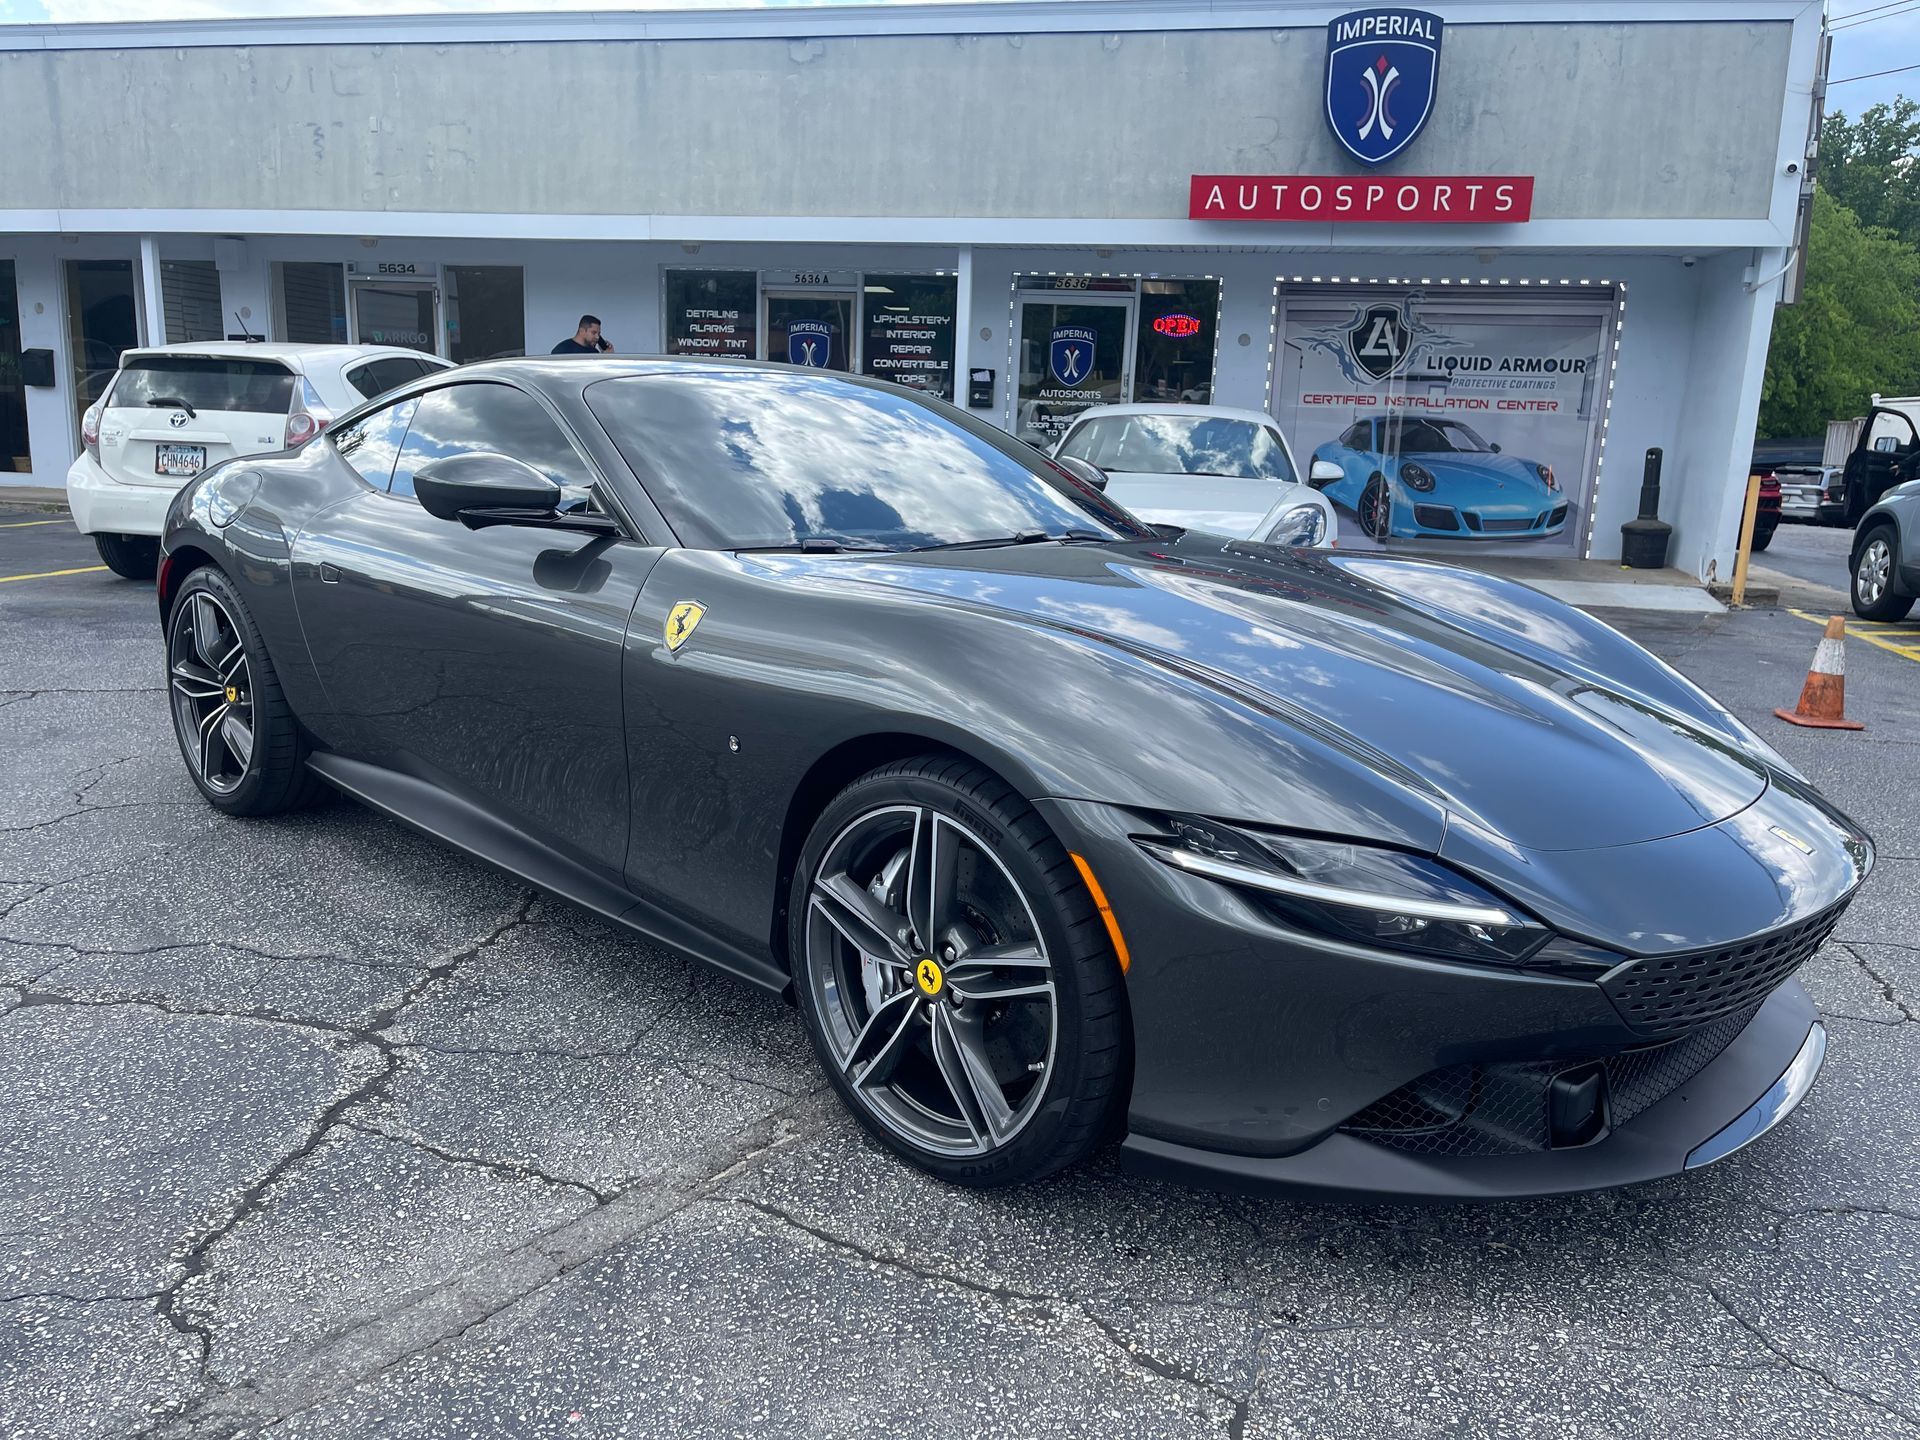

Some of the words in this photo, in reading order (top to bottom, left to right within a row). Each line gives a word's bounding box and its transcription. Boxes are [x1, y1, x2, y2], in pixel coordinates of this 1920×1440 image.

[1336, 16, 1436, 42] IMPERIAL
[1204, 184, 1514, 212] AUTOSPORTS
[379, 263, 416, 274] 5634
[1056, 278, 1088, 289] 5636
[686, 309, 738, 319] DETAILING
[873, 314, 950, 325] UPHOLSTERY
[689, 324, 735, 333] ALARMS
[790, 323, 829, 334] IMPERIAL
[1153, 317, 1200, 334] OPEN
[886, 330, 936, 340] INTERIOR
[1053, 329, 1094, 341] IMPERIAL
[678, 338, 720, 347] WINDOW
[725, 339, 747, 348] TINT
[890, 345, 932, 354] REPAIR
[873, 359, 949, 369] CONVERTIBLE
[1427, 355, 1493, 376] LIQUID
[1499, 357, 1587, 374] ARMOUR
[895, 374, 926, 383] TOPS
[1452, 378, 1506, 389] PROTECTIVE
[1509, 379, 1557, 390] COATINGS
[1039, 389, 1102, 399] AUTOSPORTS
[1303, 393, 1377, 407] CERTIFIED
[1384, 395, 1489, 410] INSTALLATION
[1496, 399, 1559, 412] CENTER
[1041, 415, 1074, 423] PLEASE
[161, 454, 200, 469] CHN4646
